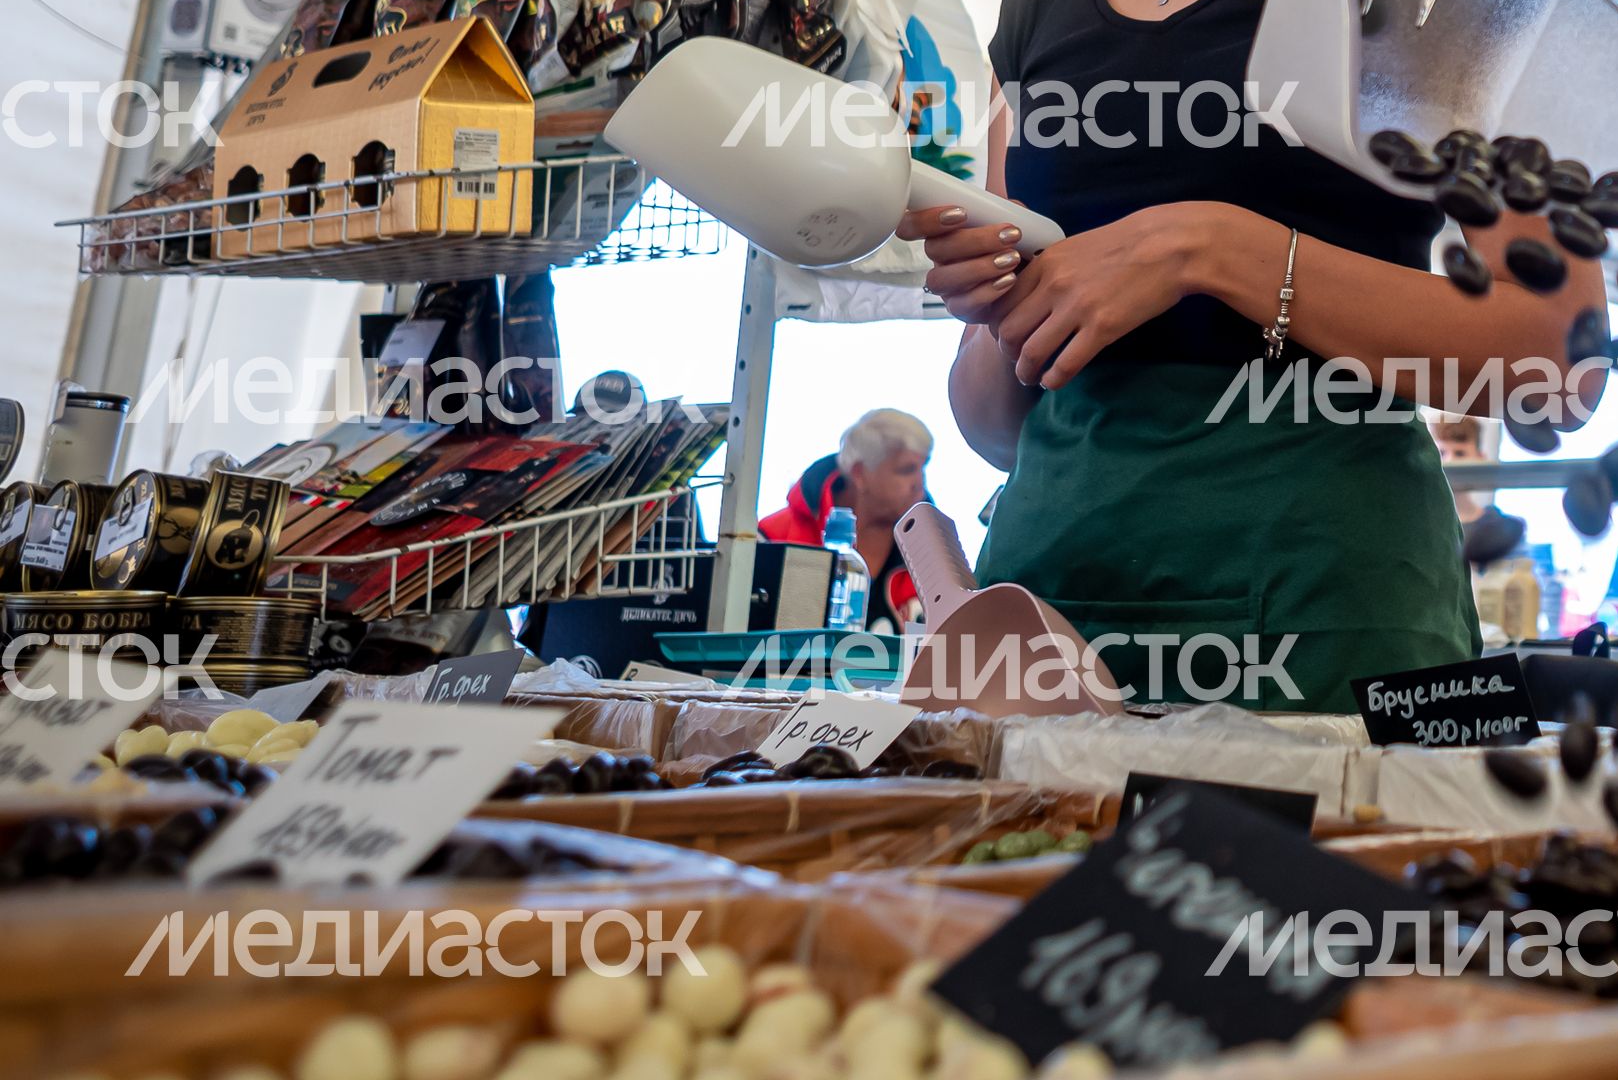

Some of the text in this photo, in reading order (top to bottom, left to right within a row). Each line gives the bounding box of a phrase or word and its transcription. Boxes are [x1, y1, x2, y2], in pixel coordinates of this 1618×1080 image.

[13, 612, 72, 631] МЯСО
[621, 606, 698, 624] ДЕЛИКАТЕС ДИЧЬ
[1366, 673, 1516, 720] Брусника
